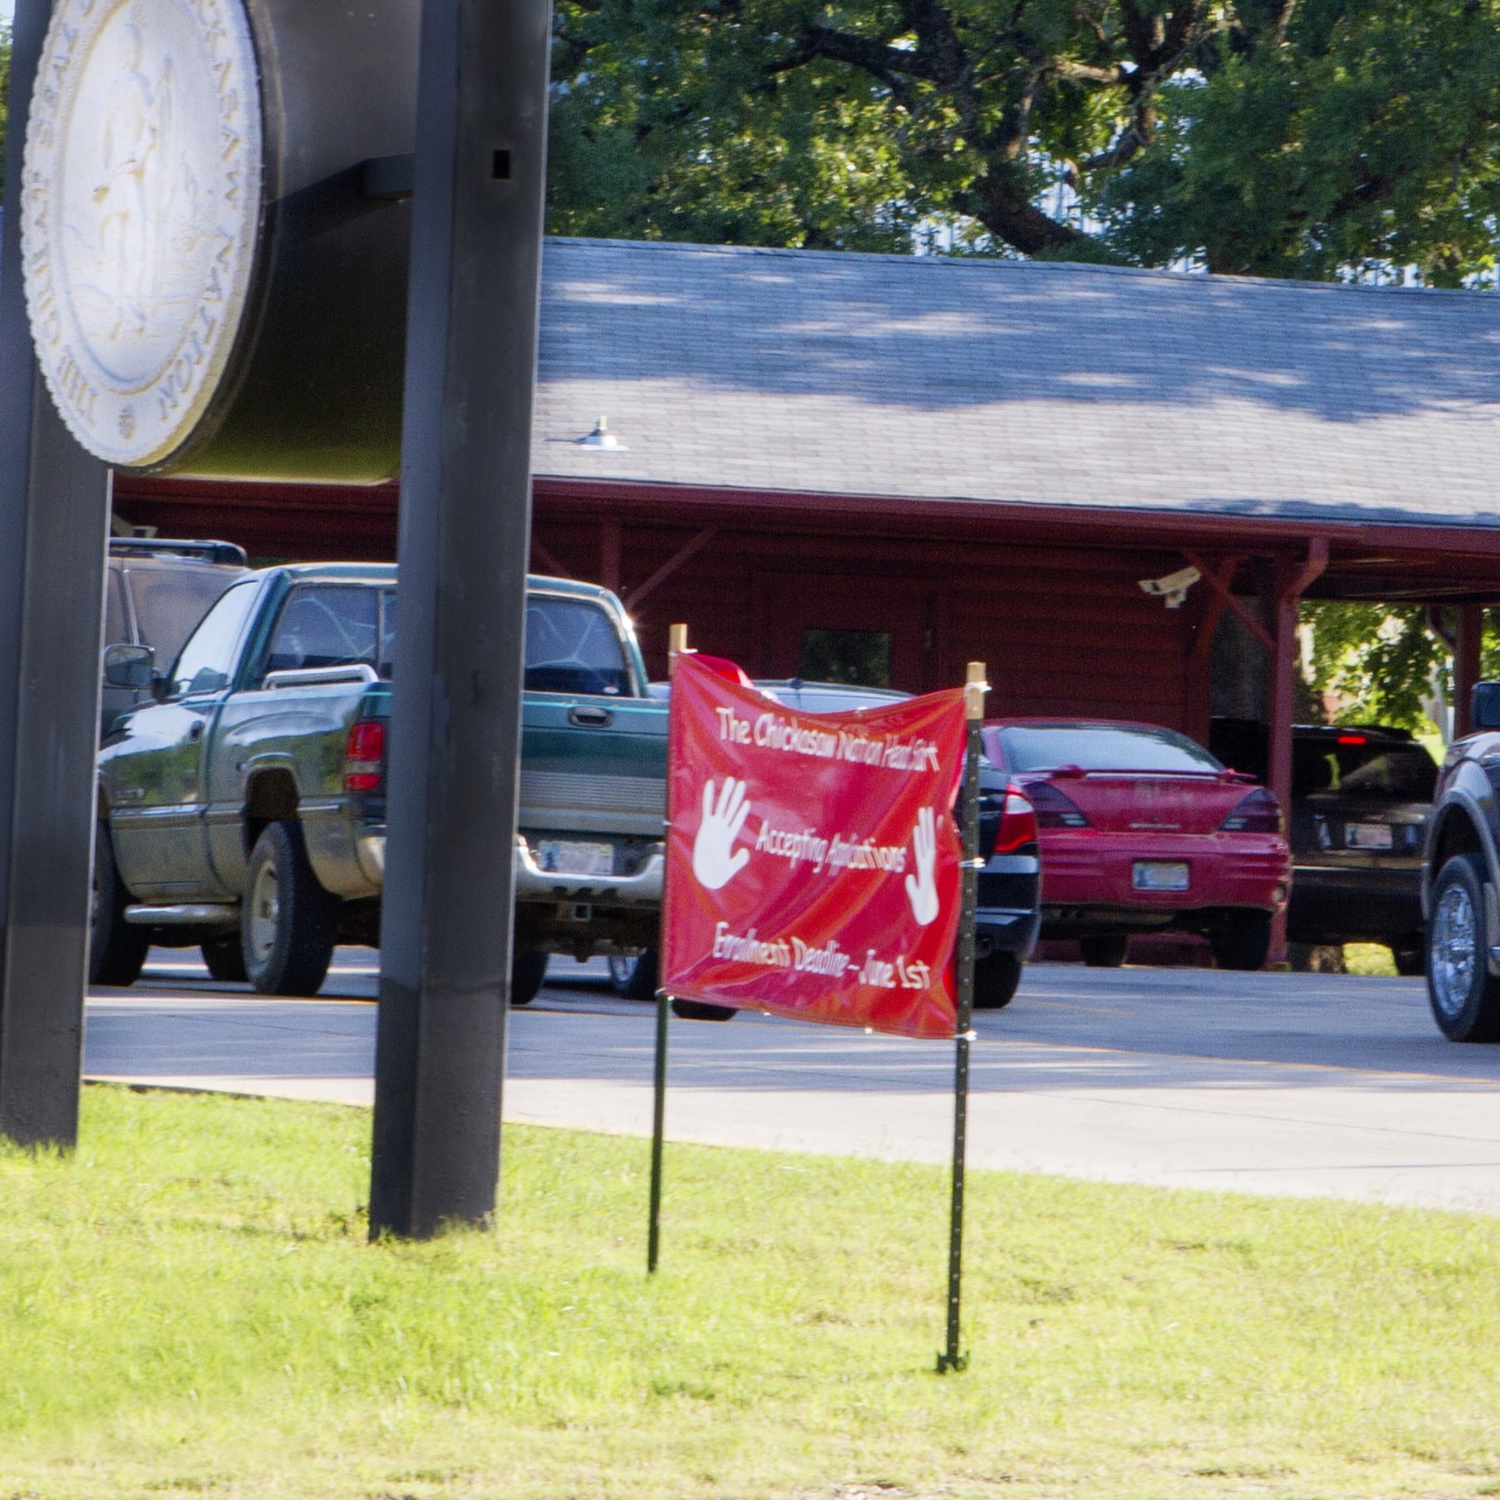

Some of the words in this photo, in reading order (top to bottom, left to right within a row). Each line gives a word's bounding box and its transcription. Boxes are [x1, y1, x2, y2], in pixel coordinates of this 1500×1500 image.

[159, 226, 236, 424] NATION
[715, 706, 752, 745] The
[754, 713, 838, 758] Chickasaw
[756, 820, 829, 874] Accepting
[713, 921, 791, 968] Enrollment
[791, 936, 850, 977] Deadline
[859, 949, 897, 988] June
[896, 955, 931, 990] 1st
